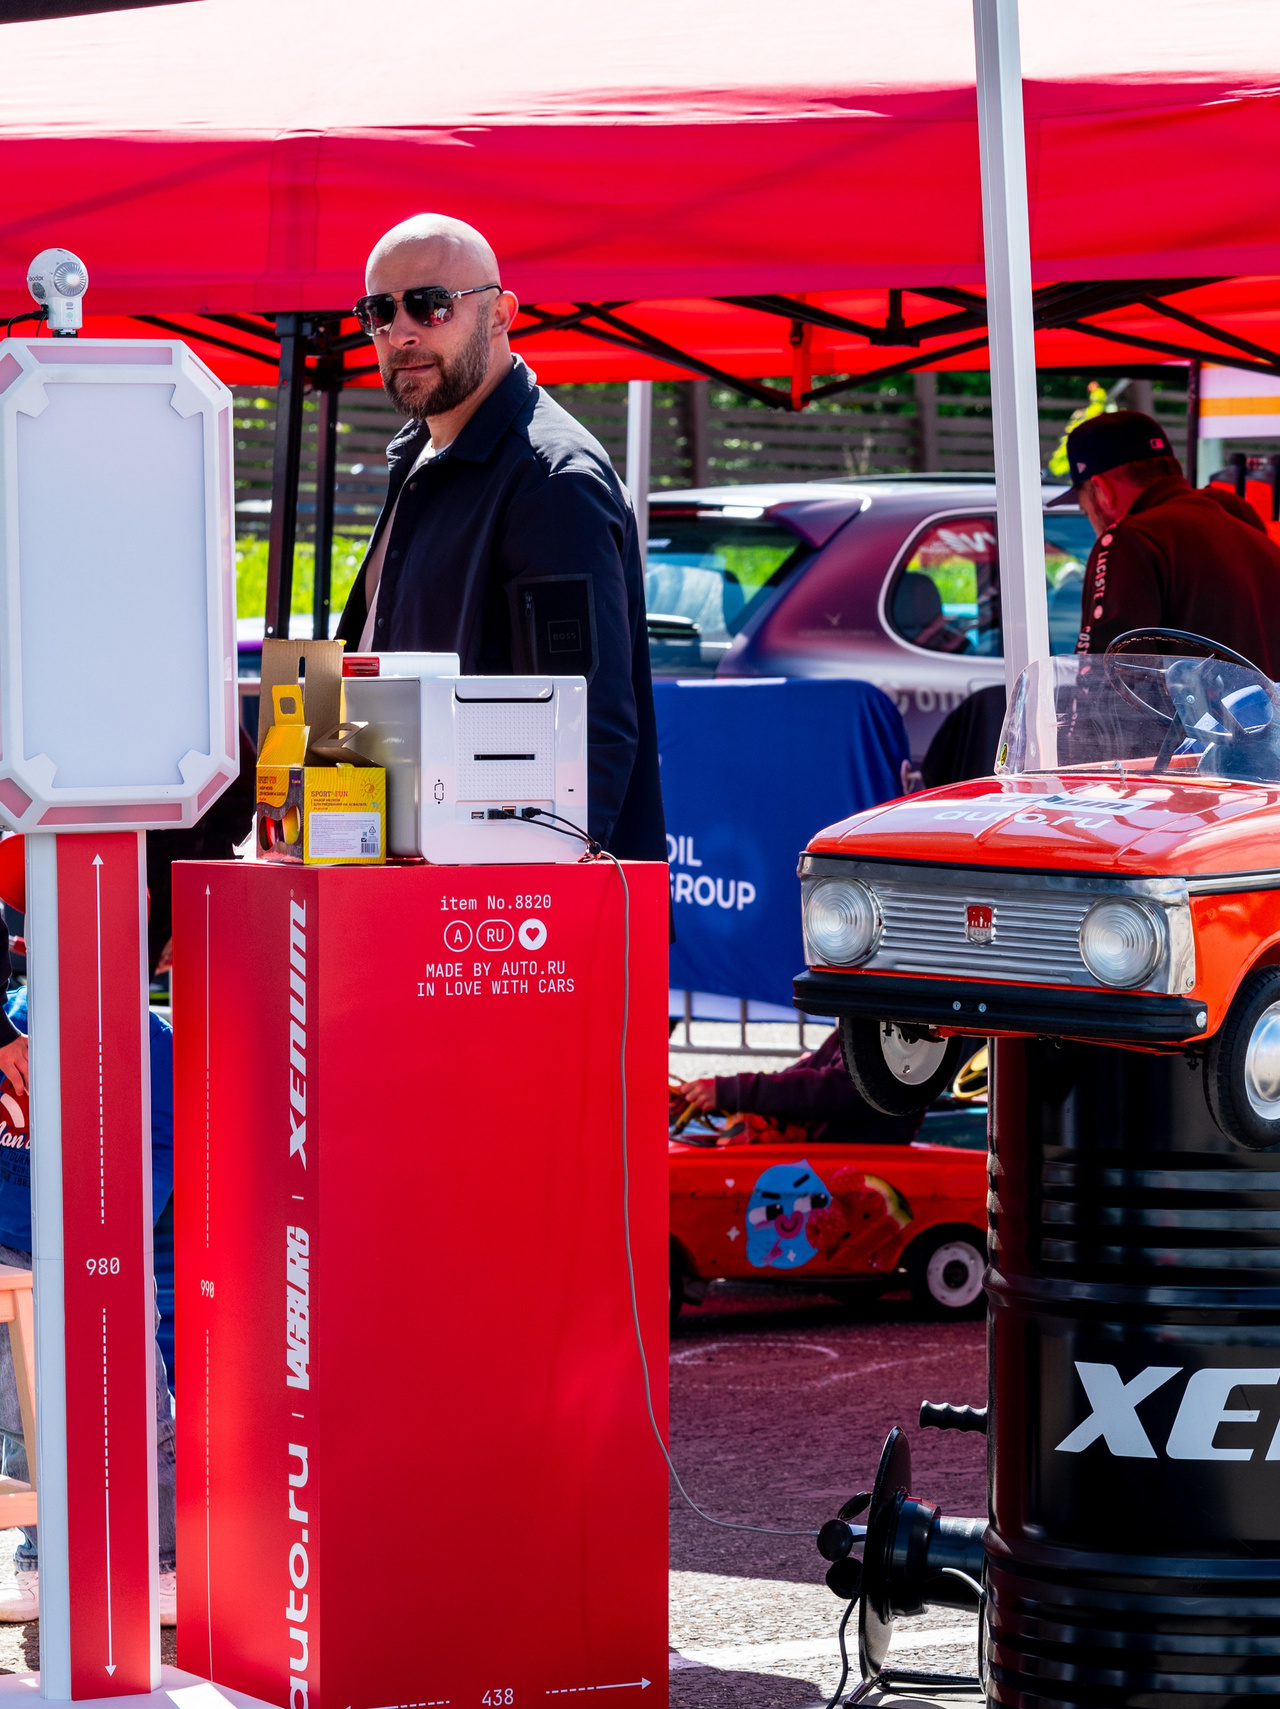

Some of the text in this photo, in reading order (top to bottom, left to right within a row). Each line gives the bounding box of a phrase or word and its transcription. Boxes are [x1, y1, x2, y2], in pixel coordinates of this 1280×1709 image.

[552, 632, 577, 641] BOSS
[670, 872, 756, 911] ROUP
[440, 894, 552, 911] item No.8820
[486, 928, 505, 942] RU
[426, 960, 566, 978] MADE BY AUTO.RU
[417, 978, 575, 997] IN LOVE WITH CARS
[86, 1257, 120, 1276] 980
[200, 1279, 215, 1298] 990
[481, 1688, 514, 1707] 438
